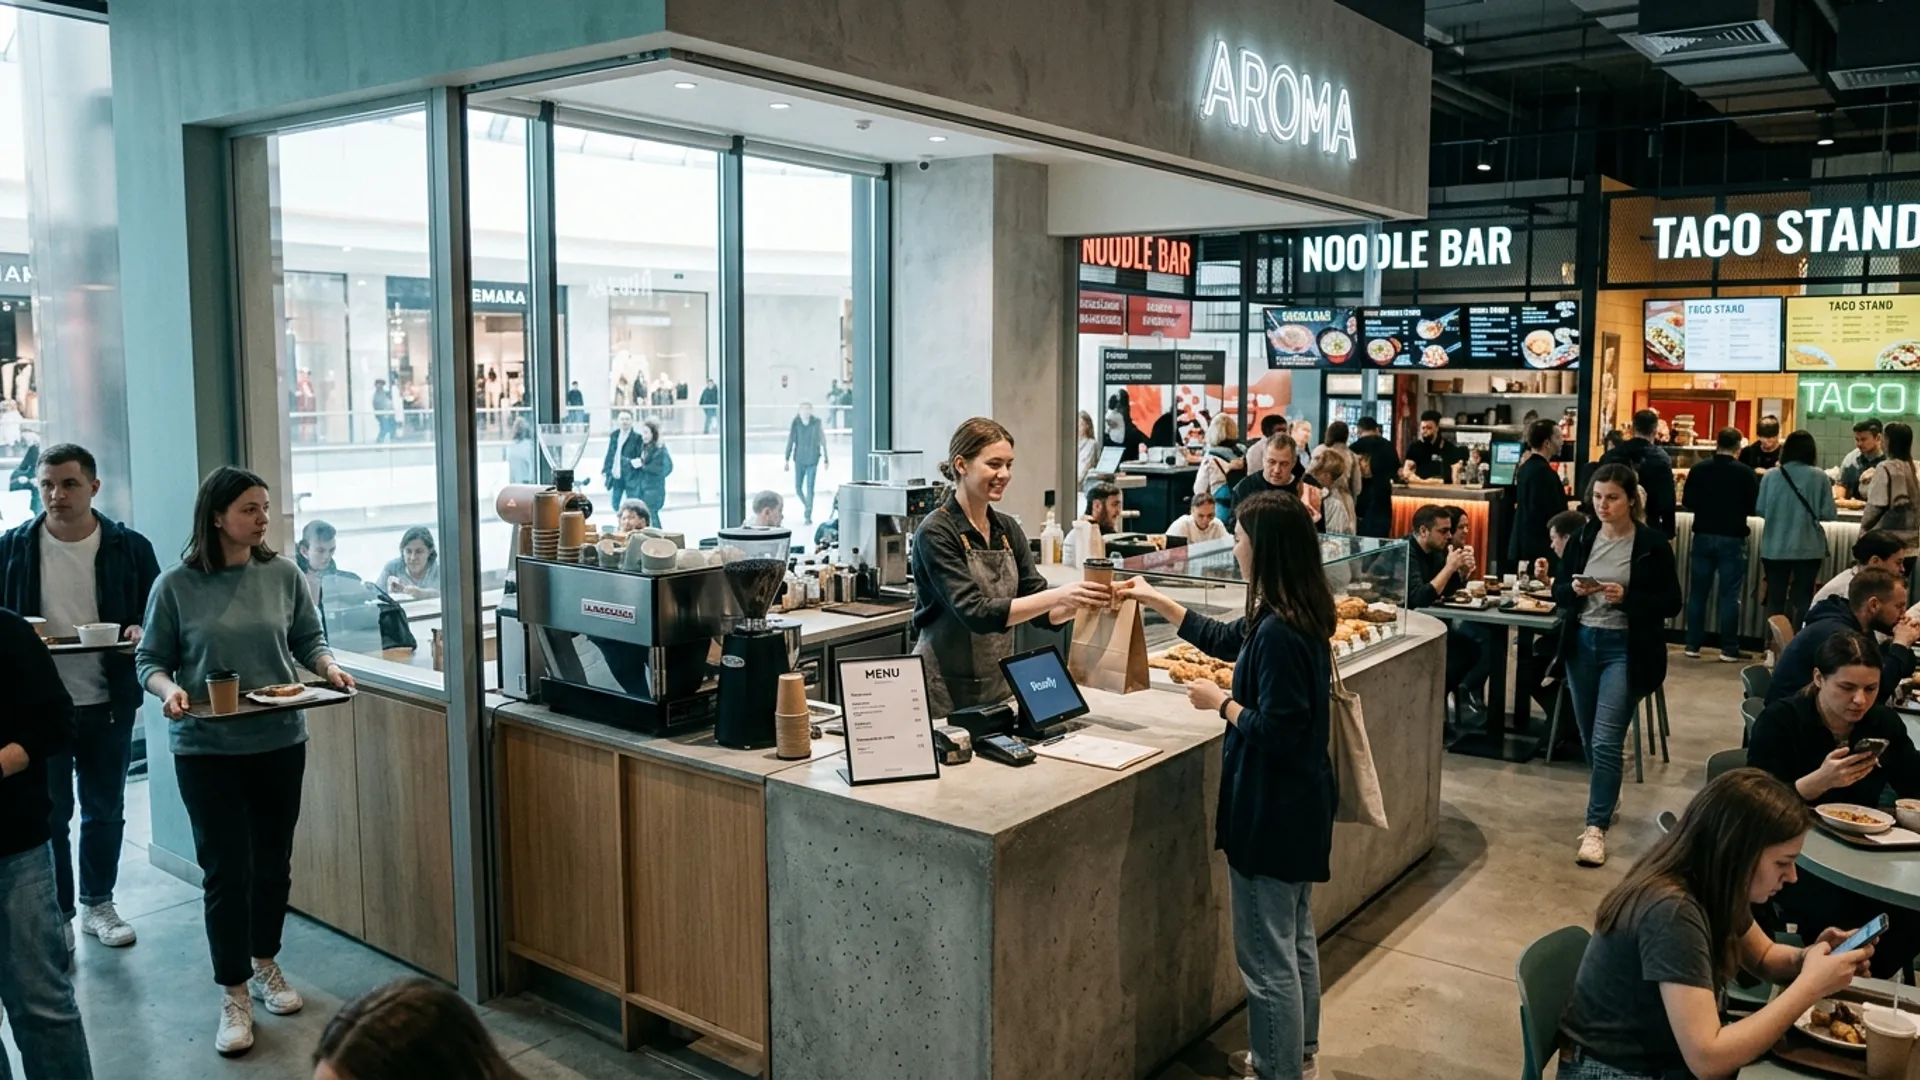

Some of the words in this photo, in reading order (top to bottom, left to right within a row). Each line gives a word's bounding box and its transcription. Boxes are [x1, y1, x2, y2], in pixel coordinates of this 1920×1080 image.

[1203, 40, 1357, 160] AROMA
[1439, 226, 1513, 267] BAR
[1653, 212, 1761, 259] TACO
[1776, 203, 1920, 255] STAND
[1158, 238, 1190, 275] BAR
[1828, 301, 1856, 311] TACO
[1859, 300, 1894, 311] STAND
[1799, 382, 1906, 413] TACO
[865, 668, 900, 679] MENU
